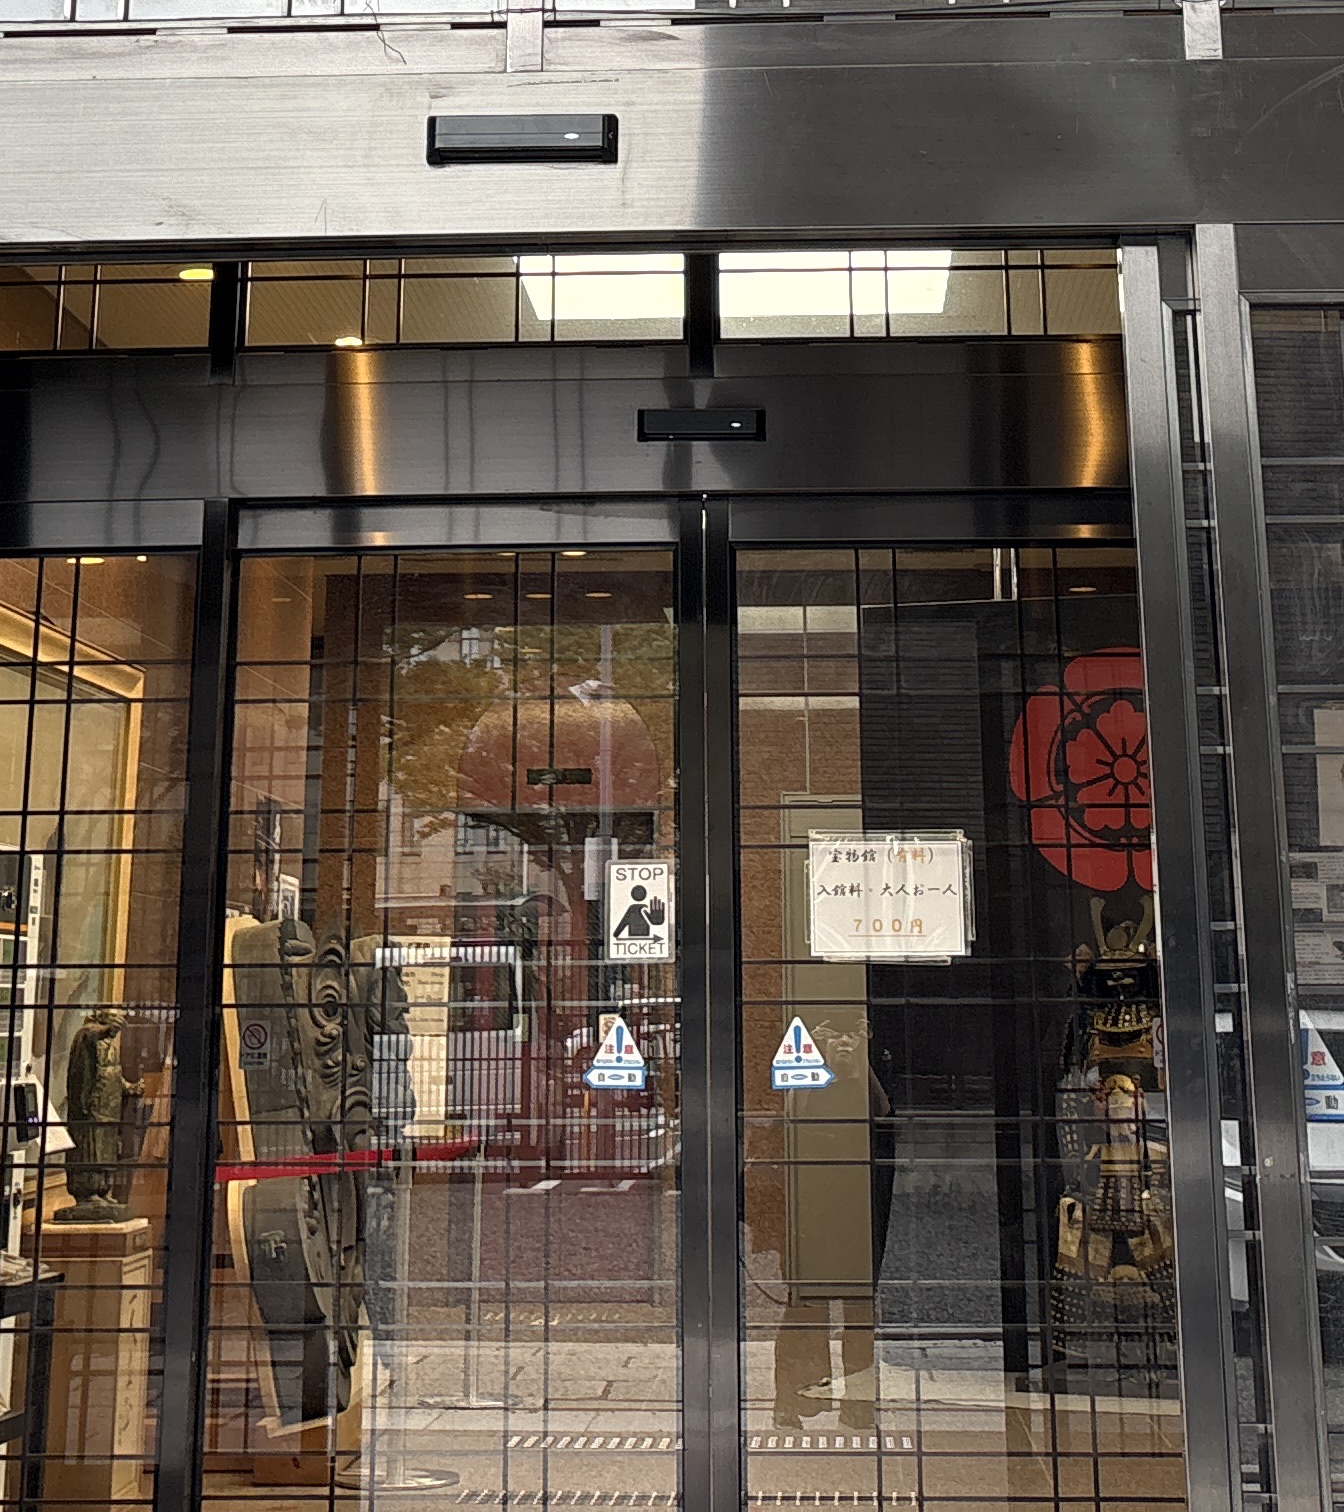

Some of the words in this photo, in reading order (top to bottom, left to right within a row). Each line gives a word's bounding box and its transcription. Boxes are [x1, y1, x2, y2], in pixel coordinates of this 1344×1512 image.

[615, 867, 665, 882] STOP
[853, 918, 924, 935] 700円
[612, 942, 666, 956] TICKET
